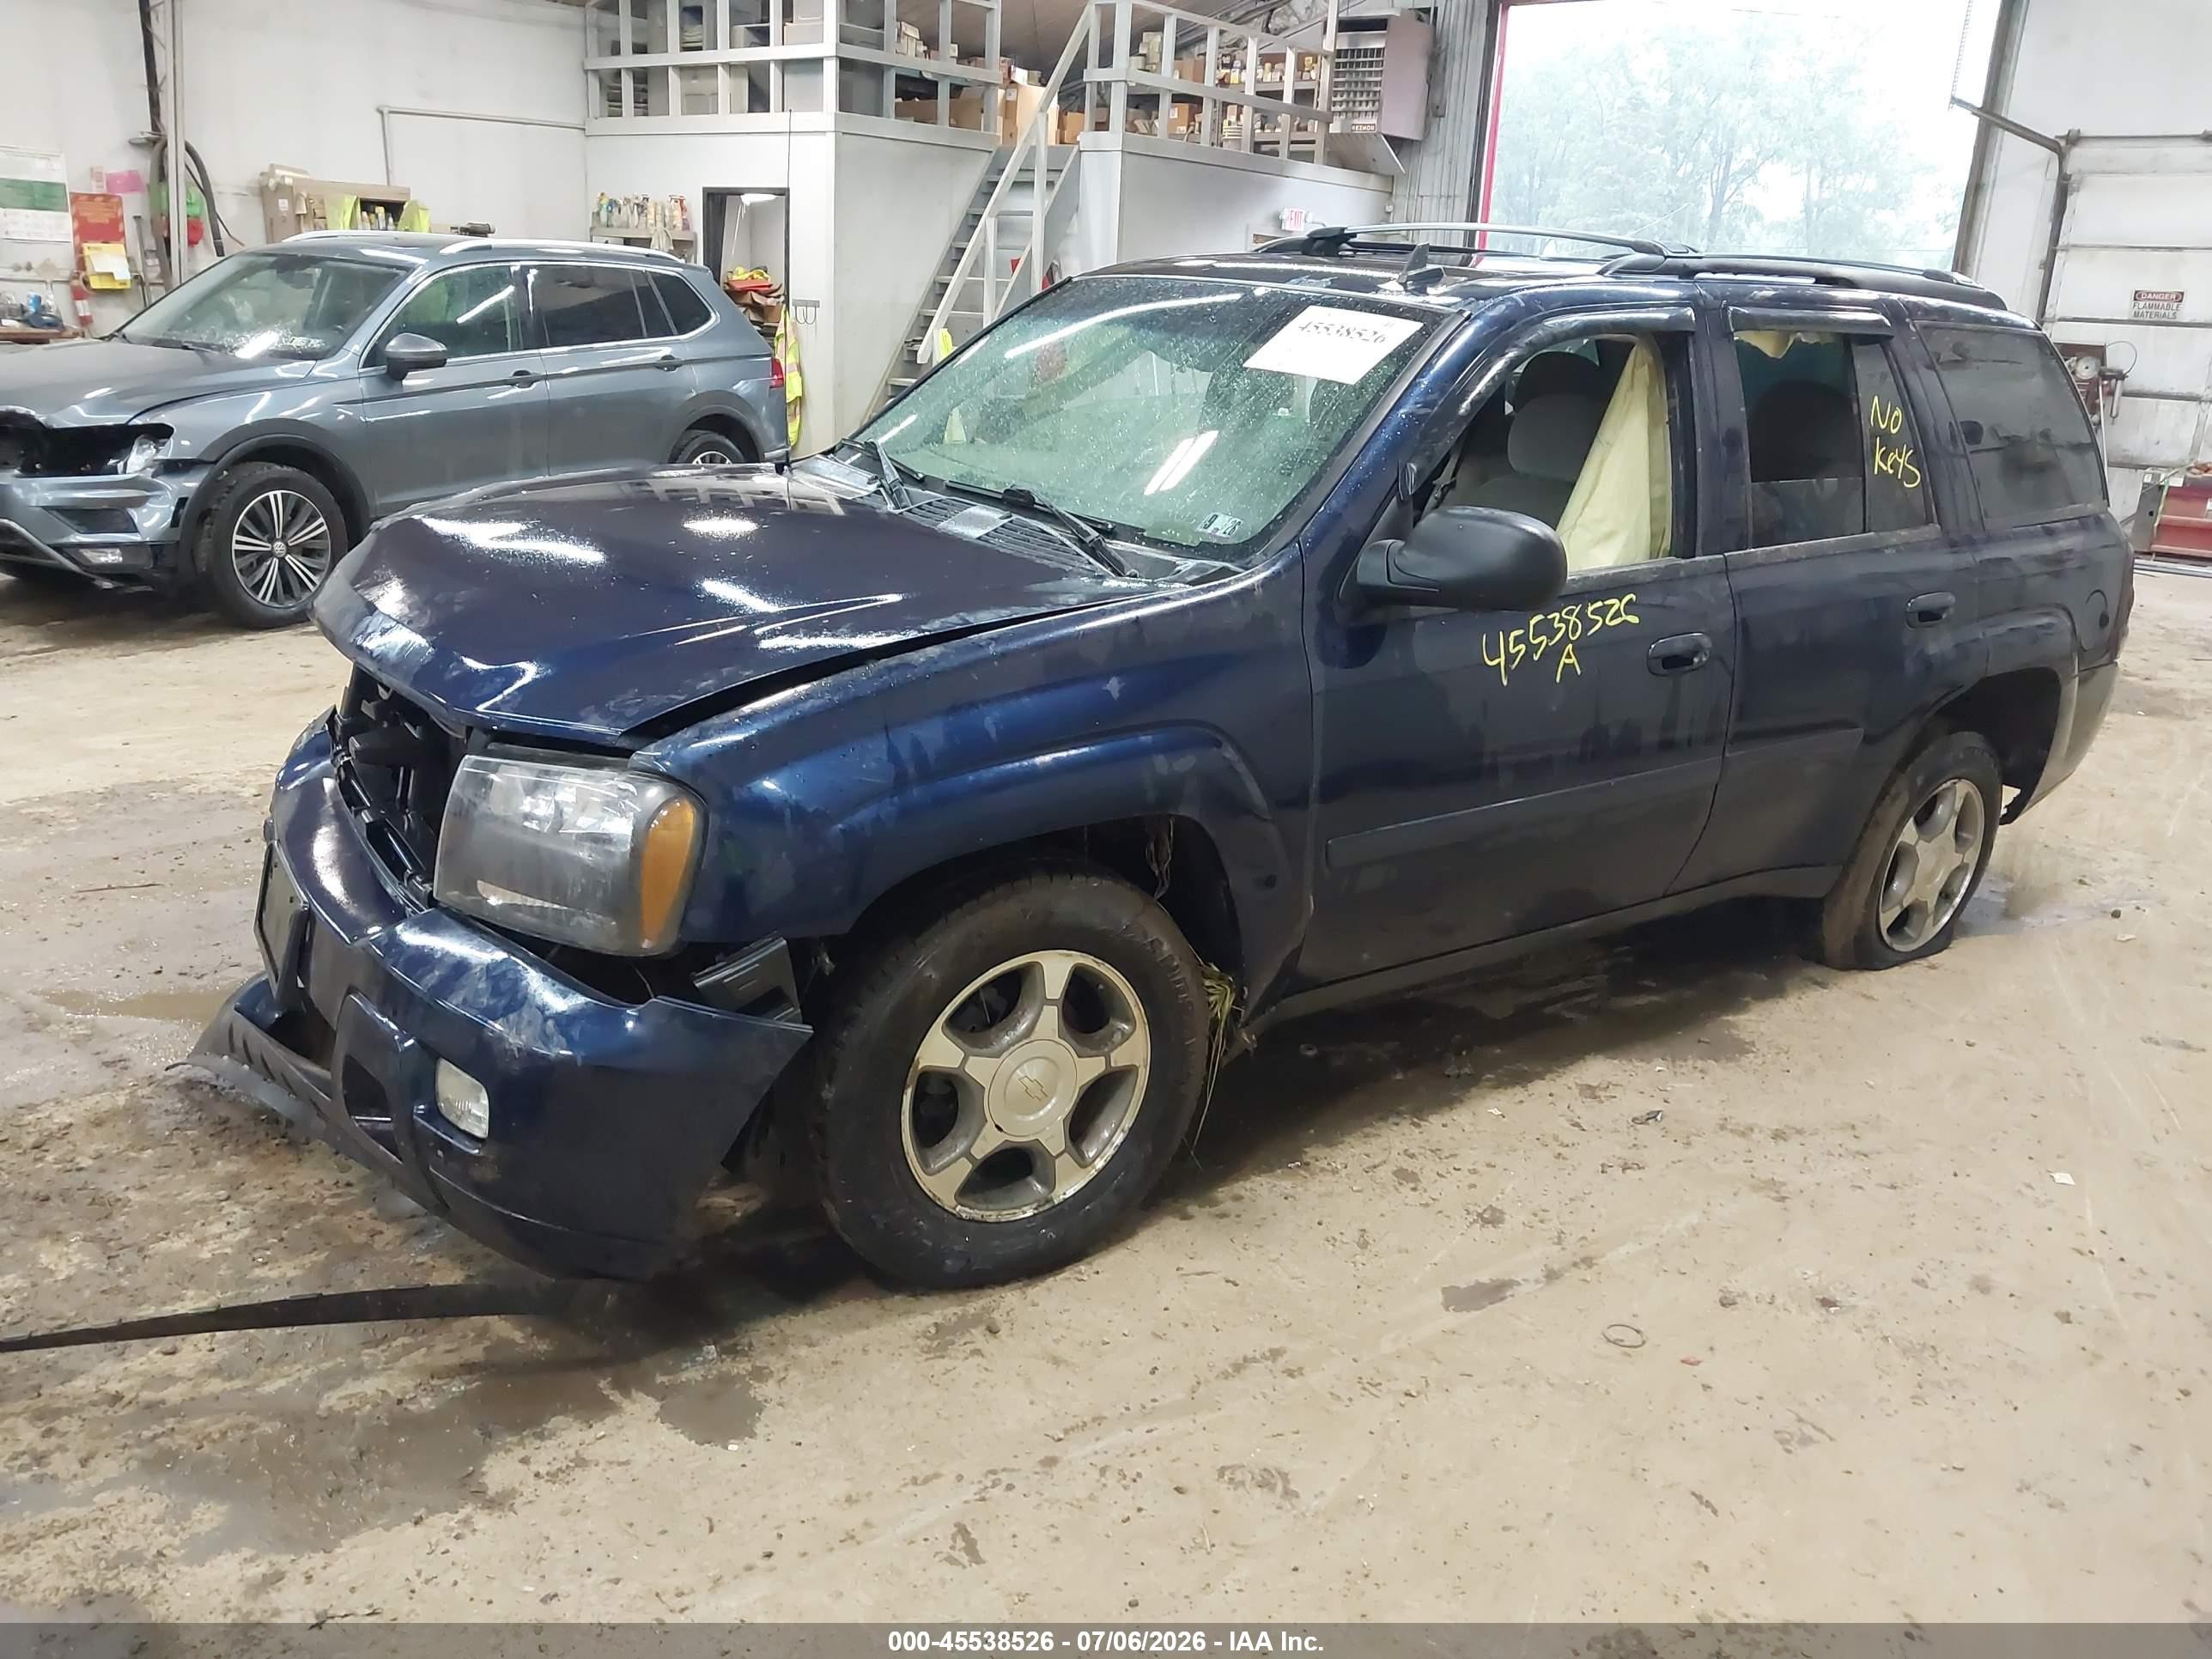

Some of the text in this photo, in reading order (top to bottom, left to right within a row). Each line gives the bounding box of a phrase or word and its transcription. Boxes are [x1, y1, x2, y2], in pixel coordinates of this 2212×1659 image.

[2141, 292, 2177, 301] DANGER
[2133, 302, 2181, 311] FLAMMABLE
[2133, 311, 2177, 319] MATERIALS
[1203, 514, 1218, 530] 9
[1481, 592, 1640, 687] 45538526
[1555, 642, 1582, 684] A
